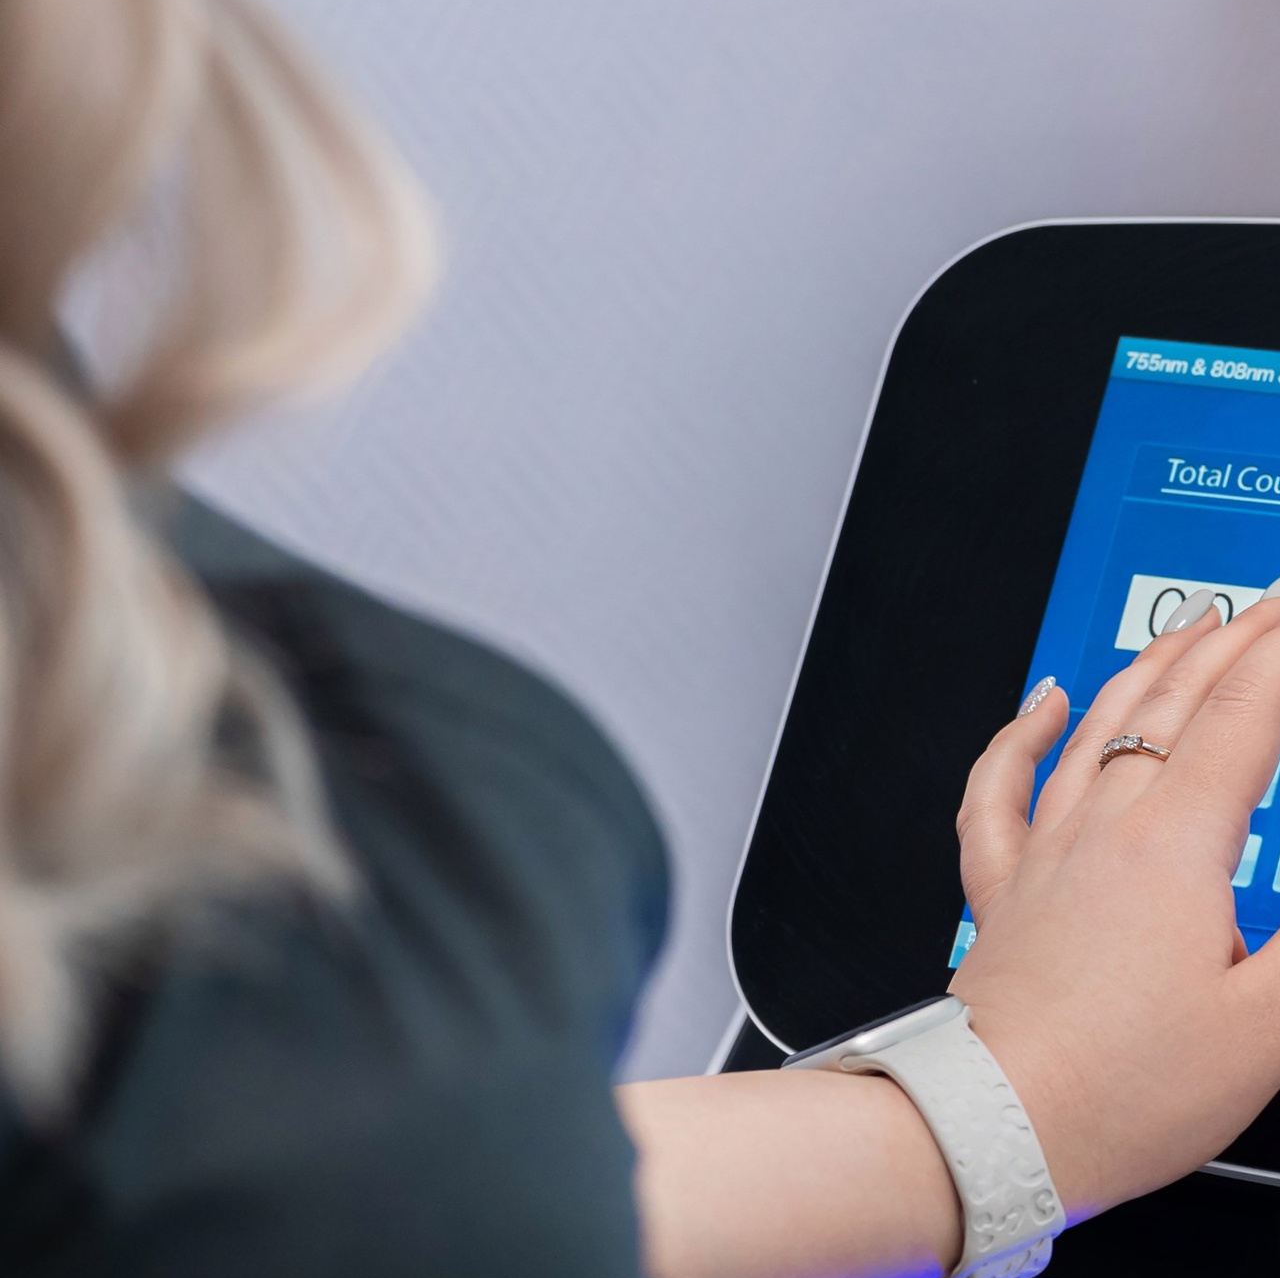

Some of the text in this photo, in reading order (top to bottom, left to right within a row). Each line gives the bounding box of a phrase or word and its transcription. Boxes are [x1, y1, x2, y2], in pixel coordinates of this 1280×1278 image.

[1125, 351, 1188, 375] 755nm
[1191, 358, 1207, 377] &
[1210, 362, 1275, 384] 808nm
[1167, 458, 1232, 489] Total
